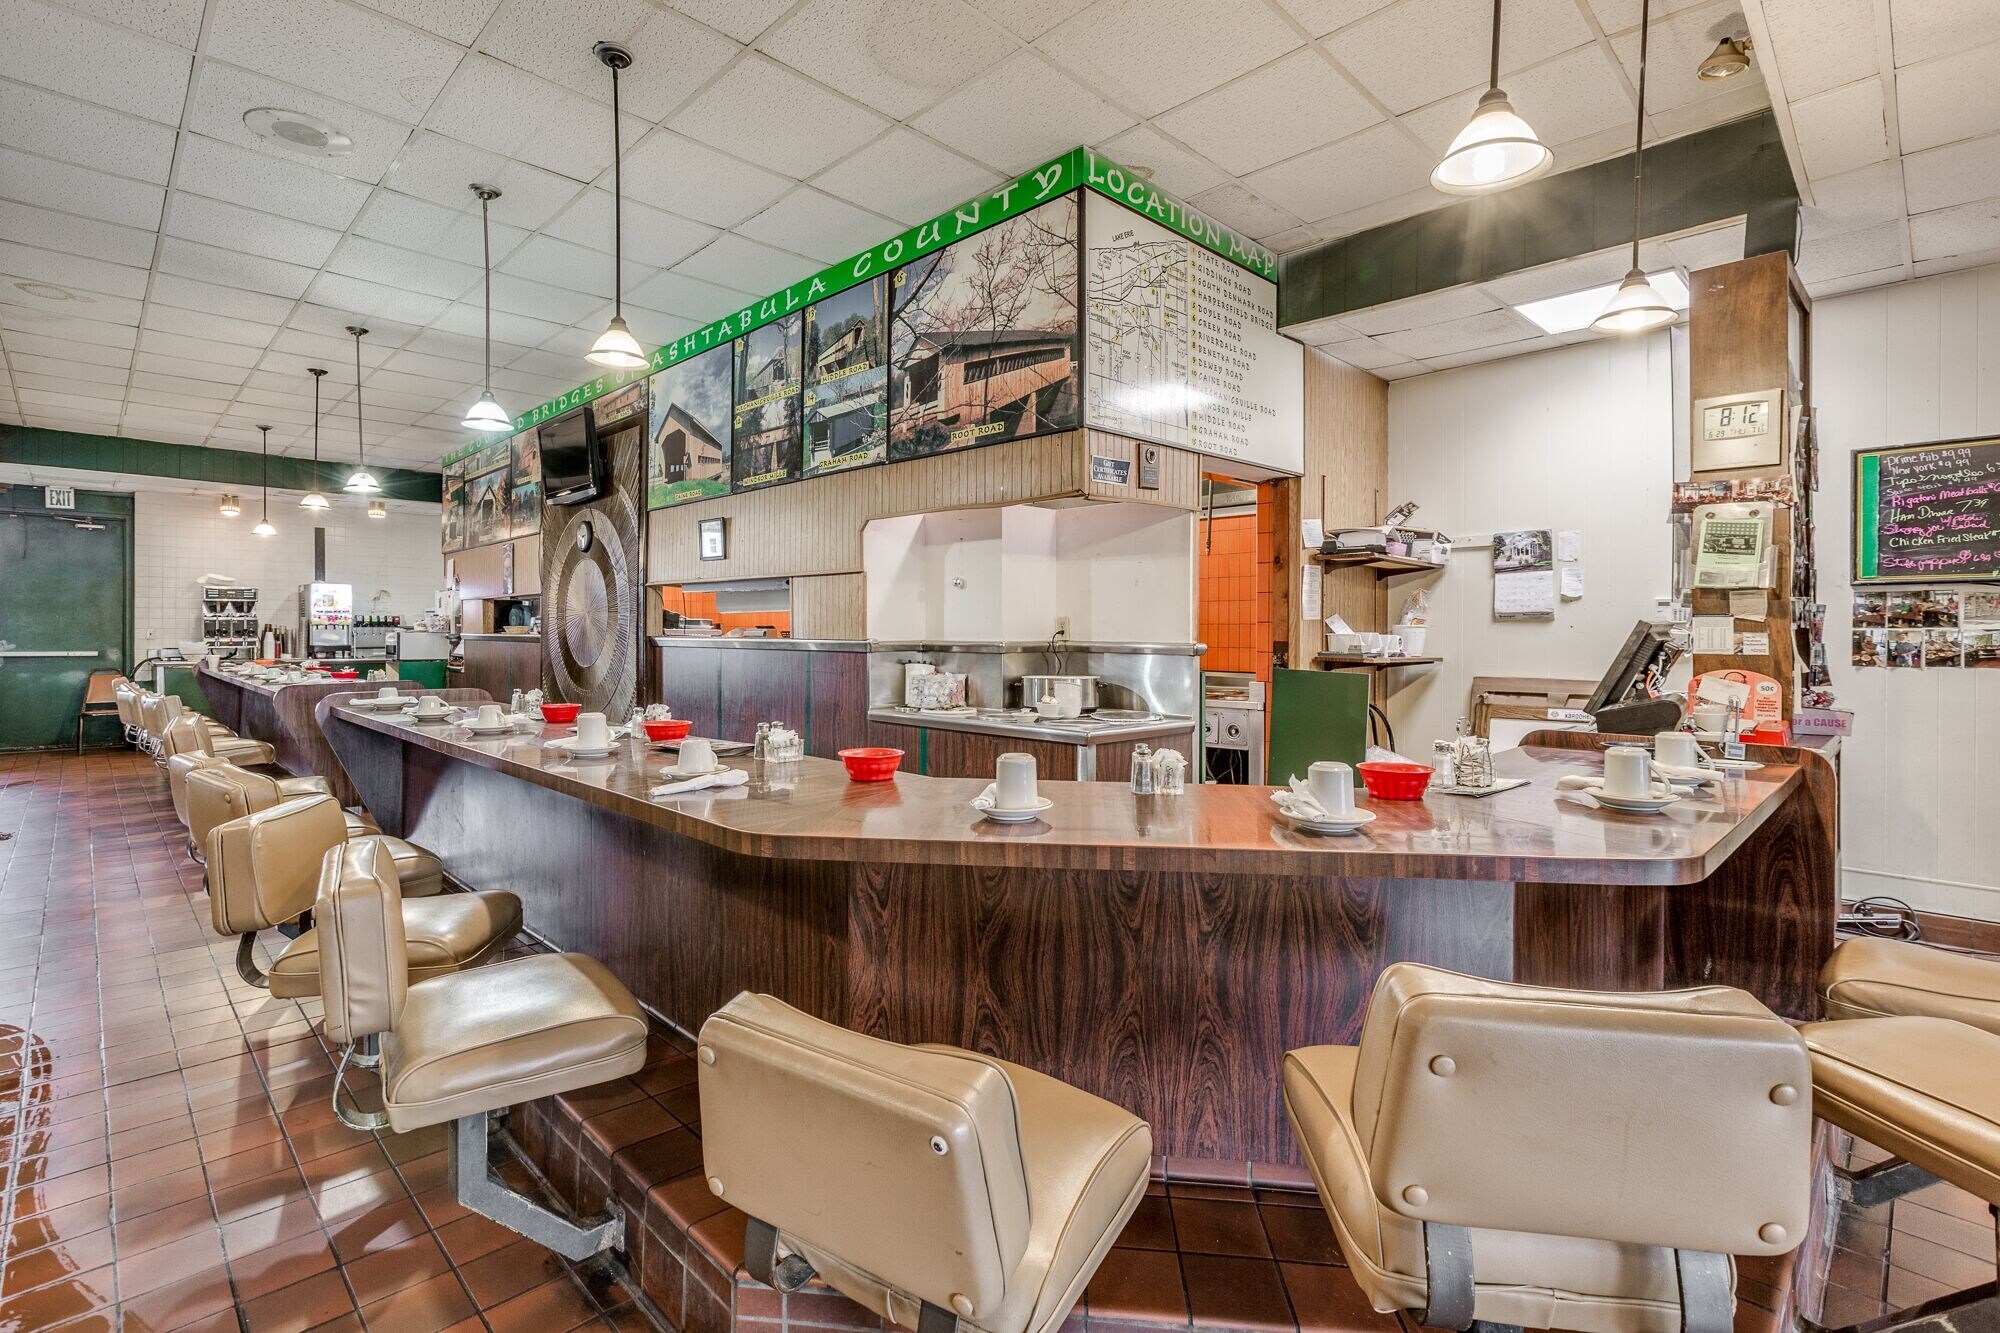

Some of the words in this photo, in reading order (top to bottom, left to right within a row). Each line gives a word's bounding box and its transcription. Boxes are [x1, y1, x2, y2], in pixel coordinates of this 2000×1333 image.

[1089, 153, 1220, 247] LOCATION
[1229, 235, 1274, 275] MAP
[1112, 232, 1125, 242] LAKE
[1124, 230, 1135, 238] ERIE
[1198, 251, 1219, 267] STATE
[1222, 263, 1240, 277] ROAD
[895, 274, 904, 283] 15
[1234, 281, 1252, 296] ROAD
[1198, 277, 1221, 294] SOUTH
[1223, 289, 1255, 311] DENMARK
[1257, 305, 1274, 319] ROAD
[467, 418, 524, 452] COVERD
[532, 378, 604, 422] BRIDGES
[651, 277, 828, 370] ASHTABULA
[853, 163, 1063, 278] COUNTY
[1198, 290, 1248, 320] HARPERSFIELD
[1250, 314, 1273, 331] BRIDGE
[1198, 304, 1221, 321] DOYLE
[1224, 315, 1242, 330] ROAD
[1198, 318, 1221, 334] CREEK
[1223, 328, 1242, 342] ROAD
[1198, 331, 1237, 353] RIVERDALE
[1239, 348, 1257, 361] ROAD
[822, 371, 848, 383] MIDDLE
[849, 363, 868, 375] ROAD
[1198, 358, 1223, 375] DEWEY
[1225, 368, 1244, 382] ROAD
[1232, 358, 1250, 371] ROAD
[784, 386, 799, 397] ROAD
[1198, 372, 1220, 386] CAINE
[1223, 380, 1241, 393] ROAD
[1260, 405, 1276, 417] ROAD
[1720, 404, 1761, 427] 8:12
[952, 429, 975, 440] ROOT
[978, 423, 1003, 435] ROAD
[1199, 413, 1225, 427] MIDDLE
[1228, 421, 1246, 433] ROAD
[1199, 427, 1229, 441] GRAHAM
[1231, 435, 1249, 447] ROAD
[1199, 440, 1217, 451] ROOT
[1220, 444, 1237, 456] ROAD
[1920, 452, 1940, 462] Rib
[819, 457, 847, 468] GRAHAM
[849, 452, 868, 462] ROAD
[1892, 465, 1911, 476] New
[49, 490, 71, 506] EXIT
[1889, 537, 1934, 547] Chicken
[1937, 534, 1961, 543] Fried
[1962, 531, 1991, 542] Steak
[1813, 718, 1847, 728] CAUSE
